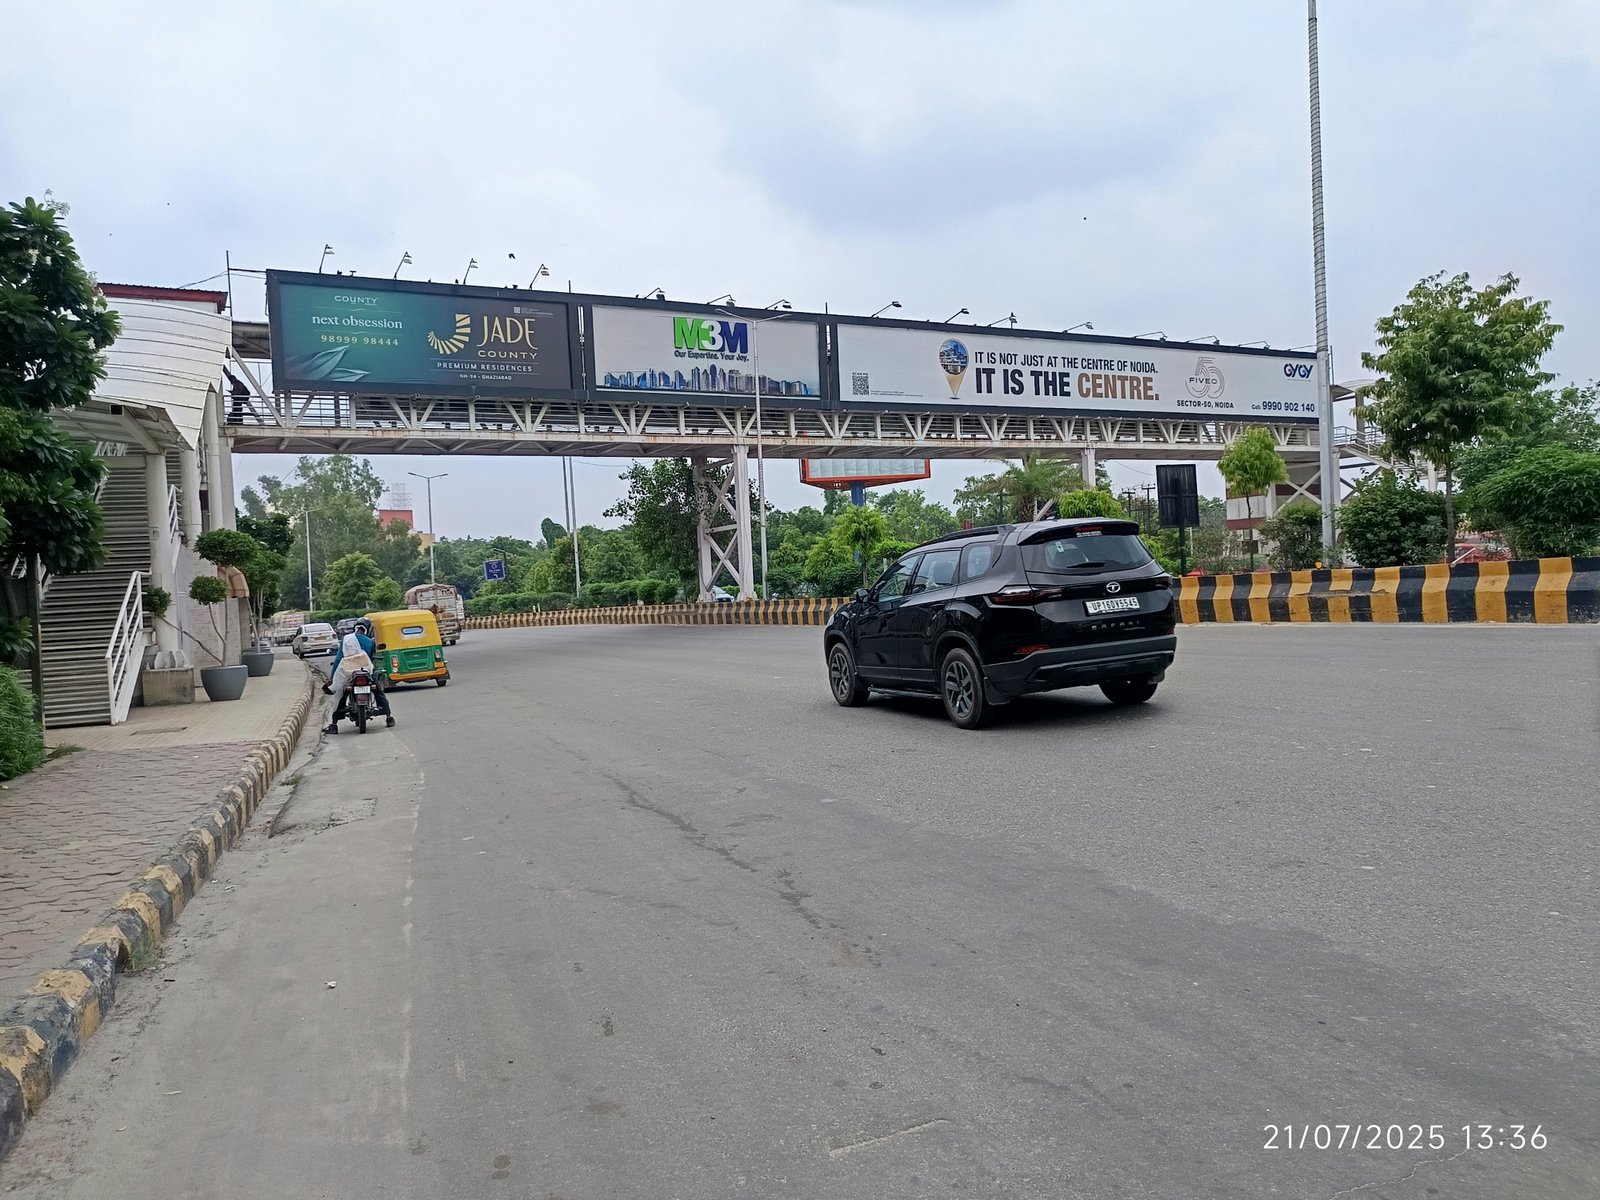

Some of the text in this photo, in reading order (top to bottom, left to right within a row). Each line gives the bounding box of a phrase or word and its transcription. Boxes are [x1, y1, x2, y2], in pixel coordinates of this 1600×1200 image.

[334, 295, 379, 304] COUNTY
[312, 314, 403, 329] next obsession
[476, 315, 538, 350] JADE
[673, 317, 748, 354] M3M
[320, 335, 399, 346] 98999 98444
[477, 350, 538, 360] COUNTY
[674, 350, 687, 358] Our
[720, 352, 735, 360] Your
[436, 362, 532, 372] PREMIUM RESIDENCES
[975, 352, 1158, 373] IT IS NOT JUST AT THE CENTRE OF NOIDA.
[975, 367, 1159, 400] IT IS THE CENTRE.
[1176, 399, 1213, 409] SECTOR-50,
[1262, 401, 1282, 411] 9990
[1284, 402, 1299, 411] 902
[1301, 403, 1315, 412] 140
